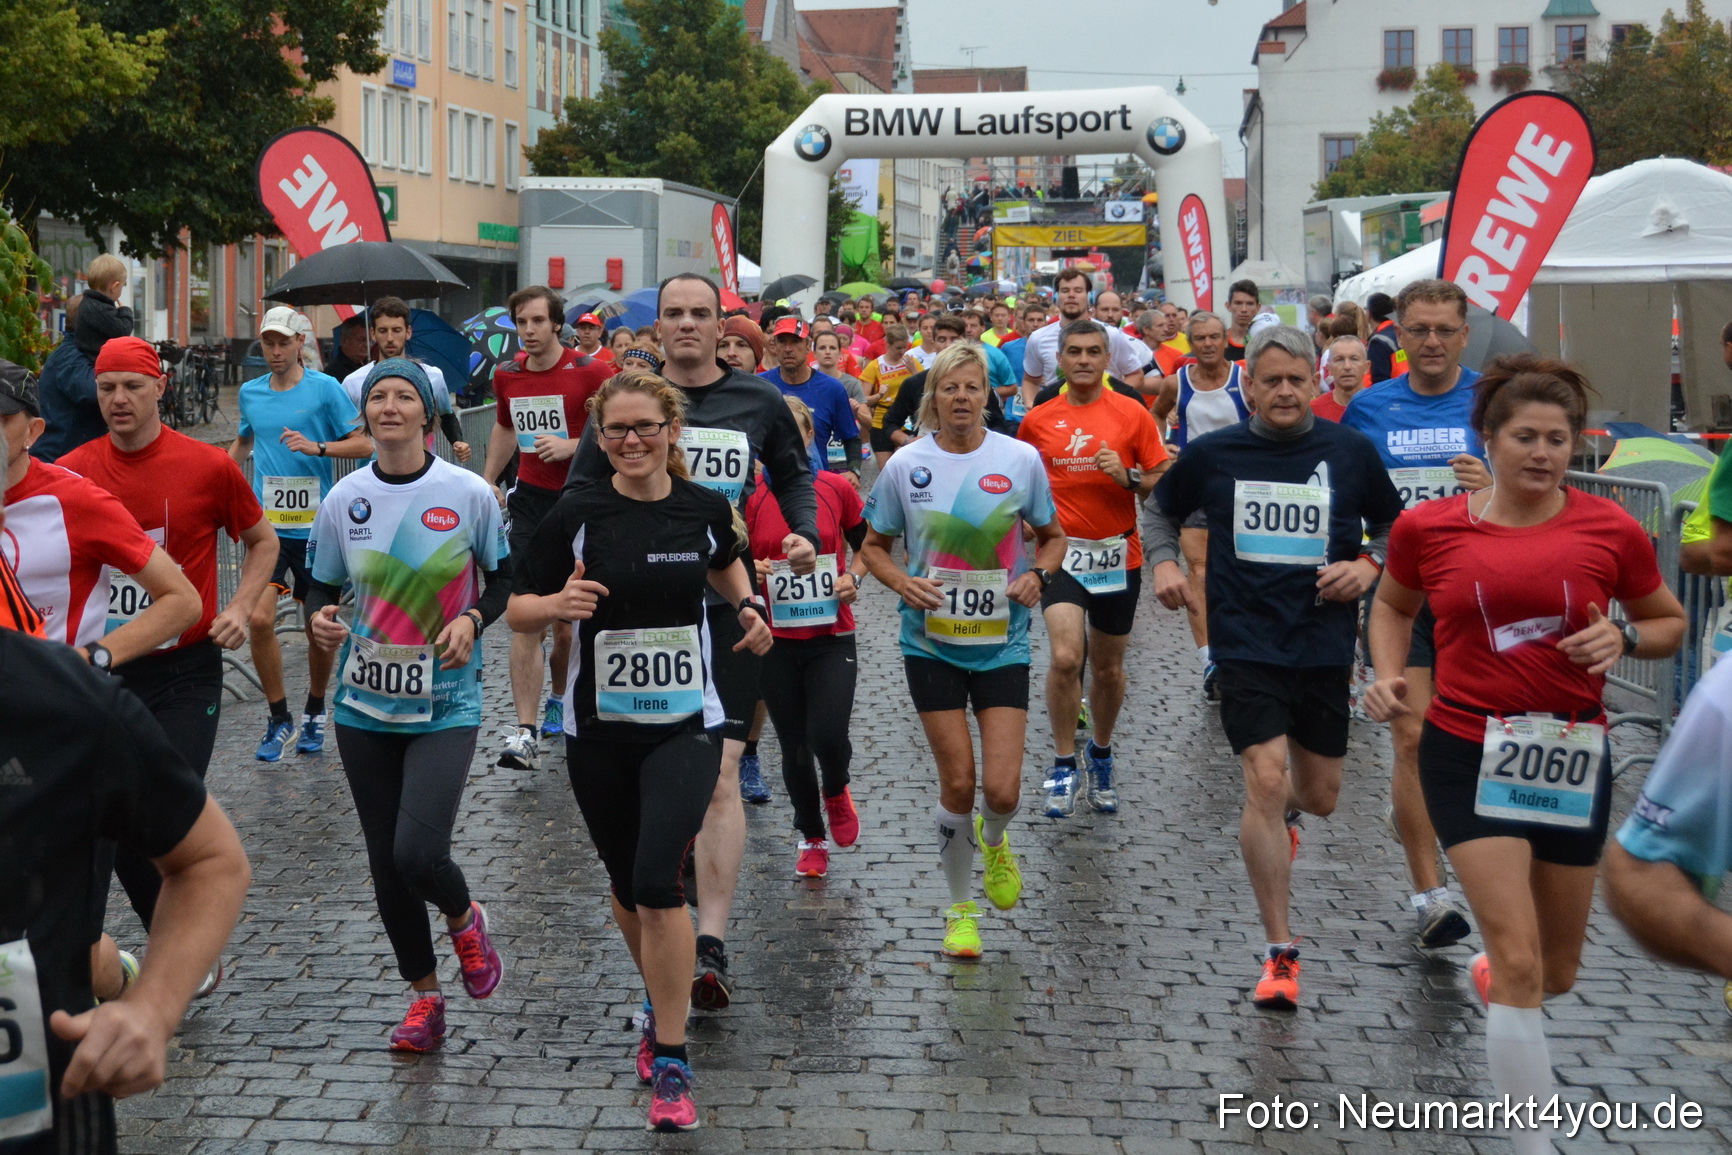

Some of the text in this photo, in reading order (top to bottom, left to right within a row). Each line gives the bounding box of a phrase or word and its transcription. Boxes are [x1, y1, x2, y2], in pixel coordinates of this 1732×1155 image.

[845, 103, 1132, 140] BMW Laufsport
[1453, 121, 1573, 312] REWE
[1053, 229, 1088, 243] ZIEL
[516, 409, 560, 432] 3046
[698, 430, 740, 442] BOCK
[1387, 428, 1466, 447] HUBER
[1403, 444, 1464, 453] TECHNOLOGY
[686, 447, 741, 478] 756
[1052, 457, 1094, 467] funrunne
[1425, 469, 1456, 480] BOC
[983, 478, 1009, 490] Hervis
[1277, 485, 1322, 497] BOCK
[274, 489, 309, 509] 200
[279, 513, 303, 522] Oliver
[427, 512, 456, 526] Hervis
[1244, 501, 1320, 534] 3009
[349, 528, 373, 536] PARTL
[656, 552, 700, 562] PFLEIDERER
[1070, 547, 1121, 571] 2145
[967, 573, 1002, 583] BOCK
[1083, 575, 1108, 586] Robert
[775, 571, 834, 601] 2519
[945, 587, 995, 617] 198
[789, 605, 824, 617] Marina
[953, 623, 981, 635] Heidi
[643, 630, 692, 643] BOCK
[351, 654, 423, 695] 3008
[607, 649, 693, 688] 2806
[633, 697, 668, 710] Irene
[1493, 740, 1590, 786] 2060
[1508, 788, 1559, 809] Andrea
